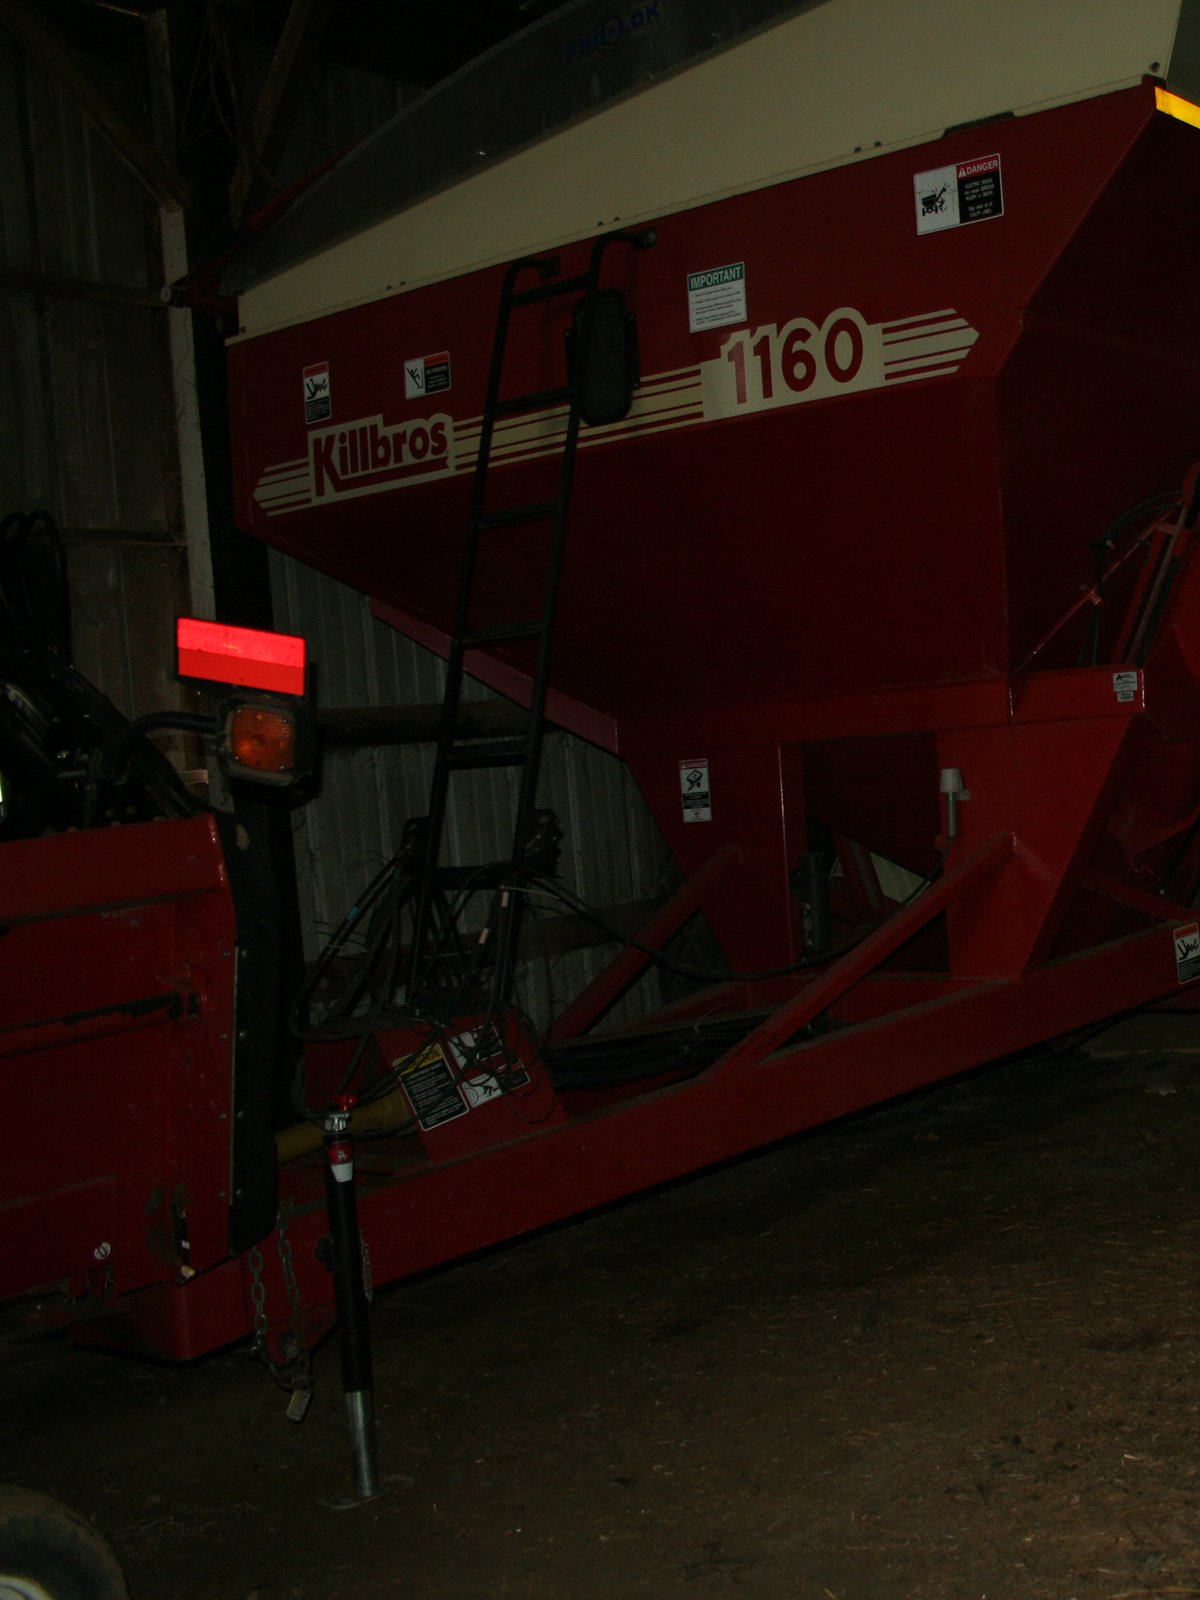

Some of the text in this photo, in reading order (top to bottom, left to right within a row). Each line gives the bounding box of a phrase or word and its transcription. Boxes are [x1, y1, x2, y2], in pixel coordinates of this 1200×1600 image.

[966, 160, 999, 175] DANGER
[690, 266, 742, 289] IMPORTANT
[727, 317, 863, 405] 1160
[313, 422, 449, 497] Killbros
